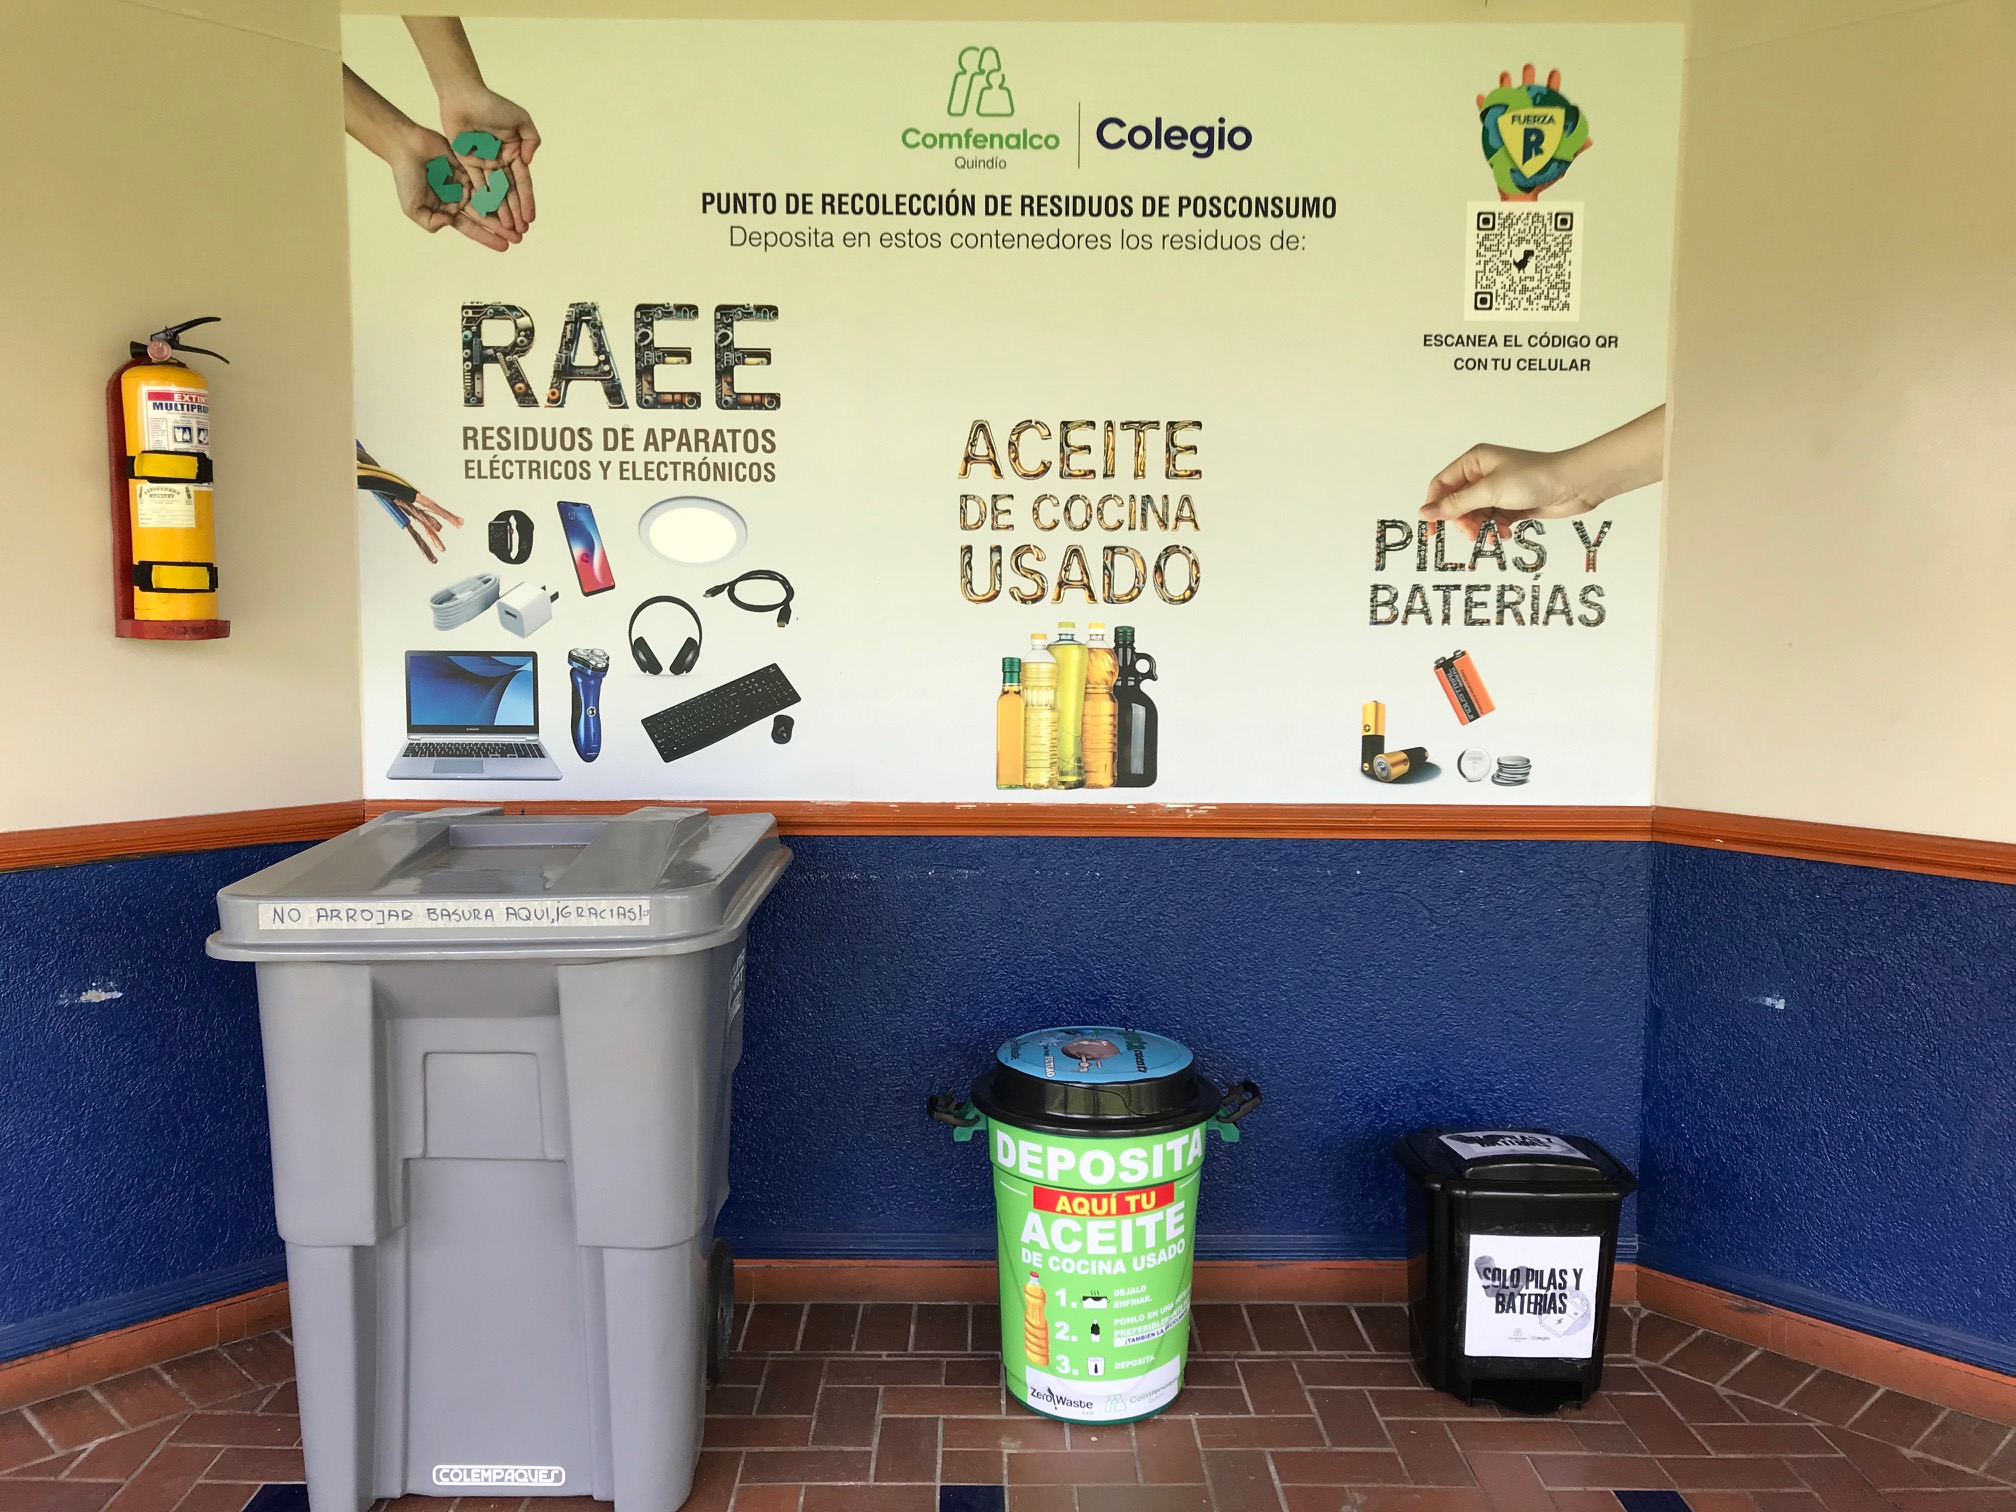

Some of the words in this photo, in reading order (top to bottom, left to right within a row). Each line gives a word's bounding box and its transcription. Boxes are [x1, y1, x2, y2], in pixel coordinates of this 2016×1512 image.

[1511, 115, 1555, 125] FUERZA
[902, 128, 1060, 150] Comfenalco
[1096, 117, 1252, 158] Colegio
[1522, 127, 1545, 166] R
[955, 156, 1006, 169] Quindío
[702, 193, 776, 214] PUNTO
[786, 193, 813, 214] DE
[822, 189, 975, 216] RECOLECCIÓN
[985, 195, 1012, 216] DE
[1021, 195, 1133, 217] RESIDUOS
[1142, 196, 1169, 217] DE
[1179, 196, 1336, 218] POSCONSUMO
[730, 226, 834, 252] Deposita
[843, 232, 870, 247] en
[880, 229, 941, 248] estos
[951, 229, 1111, 250] contenedores
[1122, 229, 1152, 250] los
[1163, 229, 1261, 250] residuos
[1270, 230, 1305, 250] de:
[1424, 334, 1498, 347] ESCANEA
[1504, 335, 1522, 347] EL
[1528, 332, 1590, 348] CÓDIGO
[1596, 336, 1618, 348] QR
[461, 302, 781, 410] RAEE
[1454, 358, 1487, 370] CON
[1491, 358, 1511, 370] TU
[1517, 358, 1590, 371] CELULAR
[463, 426, 592, 451] RESIDUOS
[603, 428, 634, 451] DE
[643, 428, 776, 453] APARATOS
[958, 419, 1202, 480] ACEITE
[465, 455, 591, 480] ELÉCTRICOS
[599, 461, 611, 480] Y
[619, 457, 775, 482] ELECTRÓNICOS
[960, 494, 1015, 531] DE
[1033, 494, 1200, 531] COCINA
[1374, 519, 1547, 573] PILAS
[1572, 519, 1613, 573] Y
[960, 544, 1201, 605] USADO
[1369, 573, 1607, 627] BATERÍAS
[273, 907, 301, 924] NO
[317, 908, 413, 925] ARROJAR
[426, 907, 495, 922] BASURA
[997, 1127, 1203, 1185] DEPOSITA
[1055, 1193, 1117, 1215] AQUÍ
[1125, 1191, 1156, 1212] TU
[1021, 1201, 1185, 1255] ACEITE
[1021, 1248, 1043, 1268] DE
[1048, 1256, 1126, 1275] COCINA
[1133, 1239, 1185, 1272] USADO
[1482, 1267, 1520, 1289] SOLO
[1525, 1268, 1568, 1290] PILAS
[1572, 1268, 1583, 1291] Y
[1055, 1288, 1077, 1308] 1.
[1114, 1285, 1147, 1297] DÉJALO
[1114, 1295, 1152, 1309] ENFRIAR.
[1495, 1290, 1568, 1315] BATERÍAS
[1114, 1314, 1145, 1326] PONLO
[1147, 1310, 1159, 1320] EN
[1160, 1302, 1174, 1315] UNA
[1055, 1322, 1078, 1342] 2.
[1056, 1355, 1079, 1375] 3.
[1030, 1386, 1053, 1403] Zero
[1055, 1394, 1093, 1409] Waste
[440, 1468, 559, 1483] COLEMPAQUES
